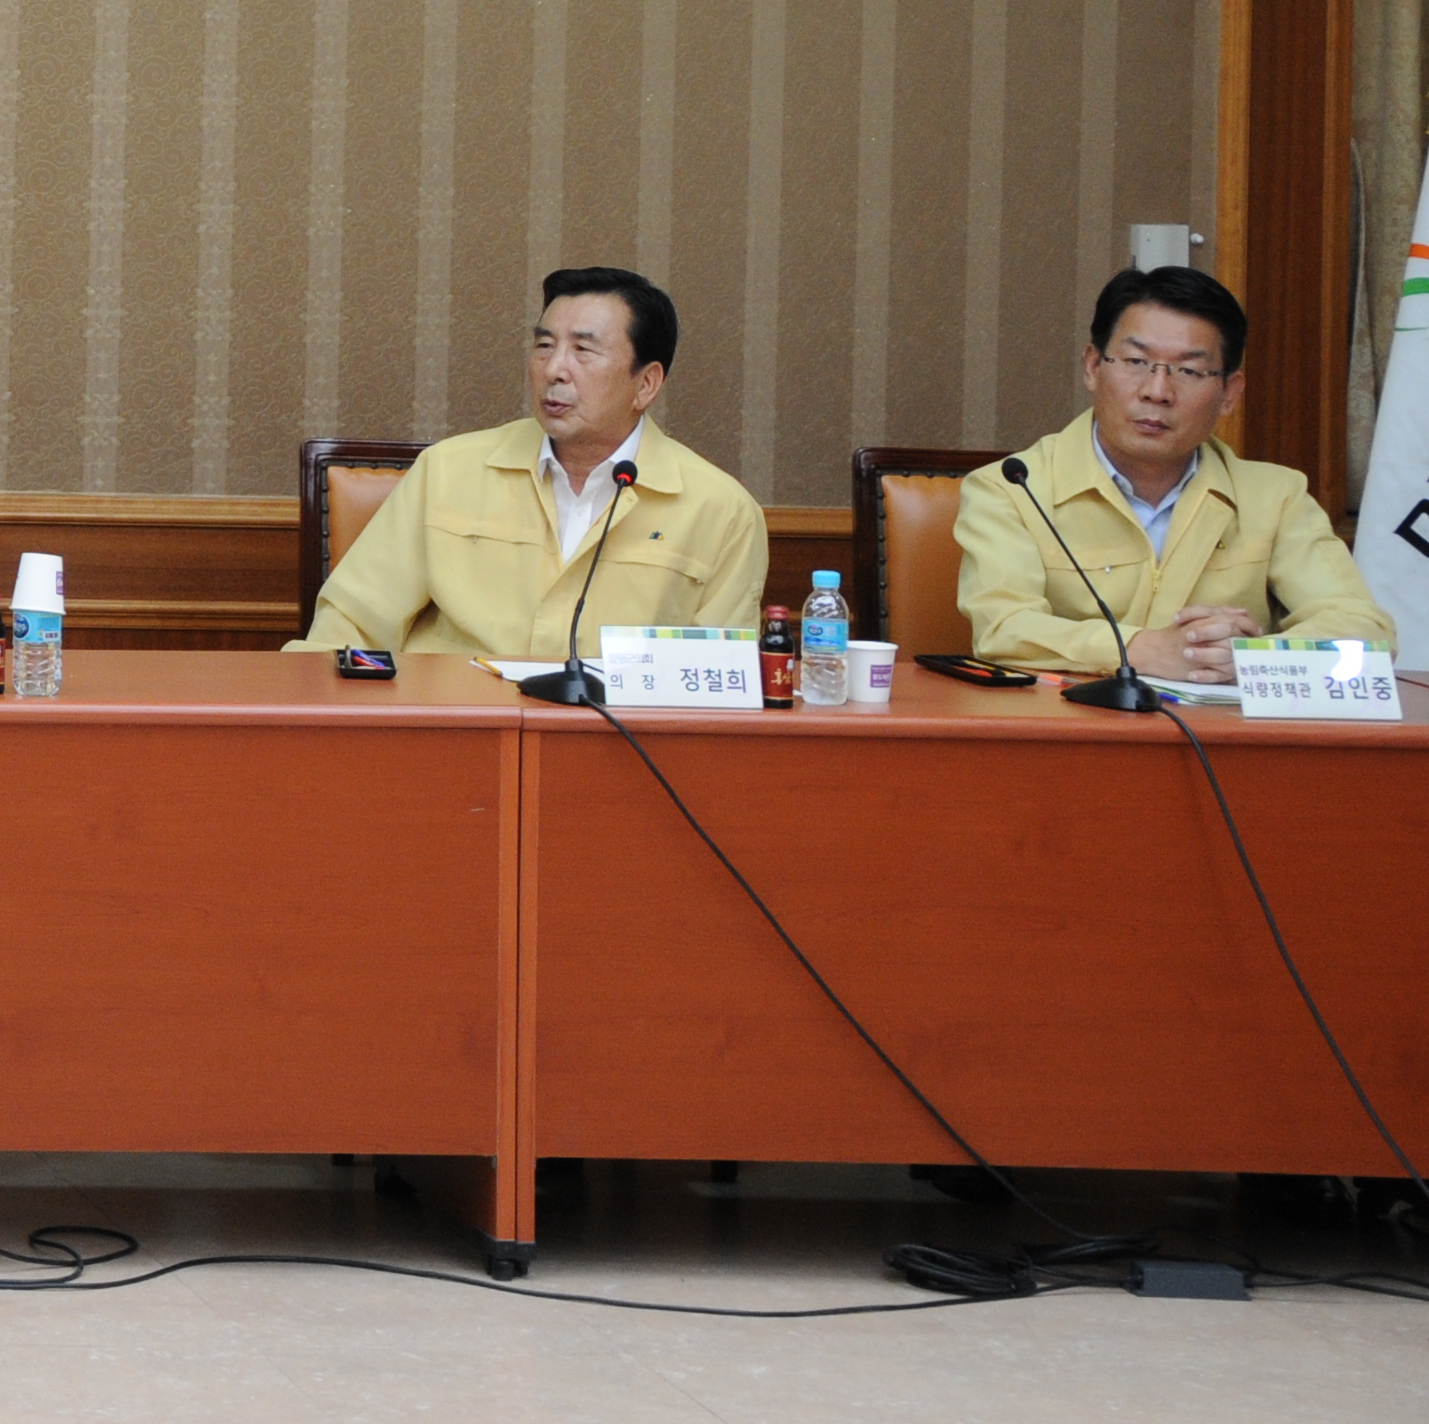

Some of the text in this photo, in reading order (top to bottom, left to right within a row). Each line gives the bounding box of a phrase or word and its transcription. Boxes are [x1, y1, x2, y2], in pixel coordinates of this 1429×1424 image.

[679, 668, 747, 694] 정철희
[1242, 676, 1393, 701] 식량정책관 김인중
